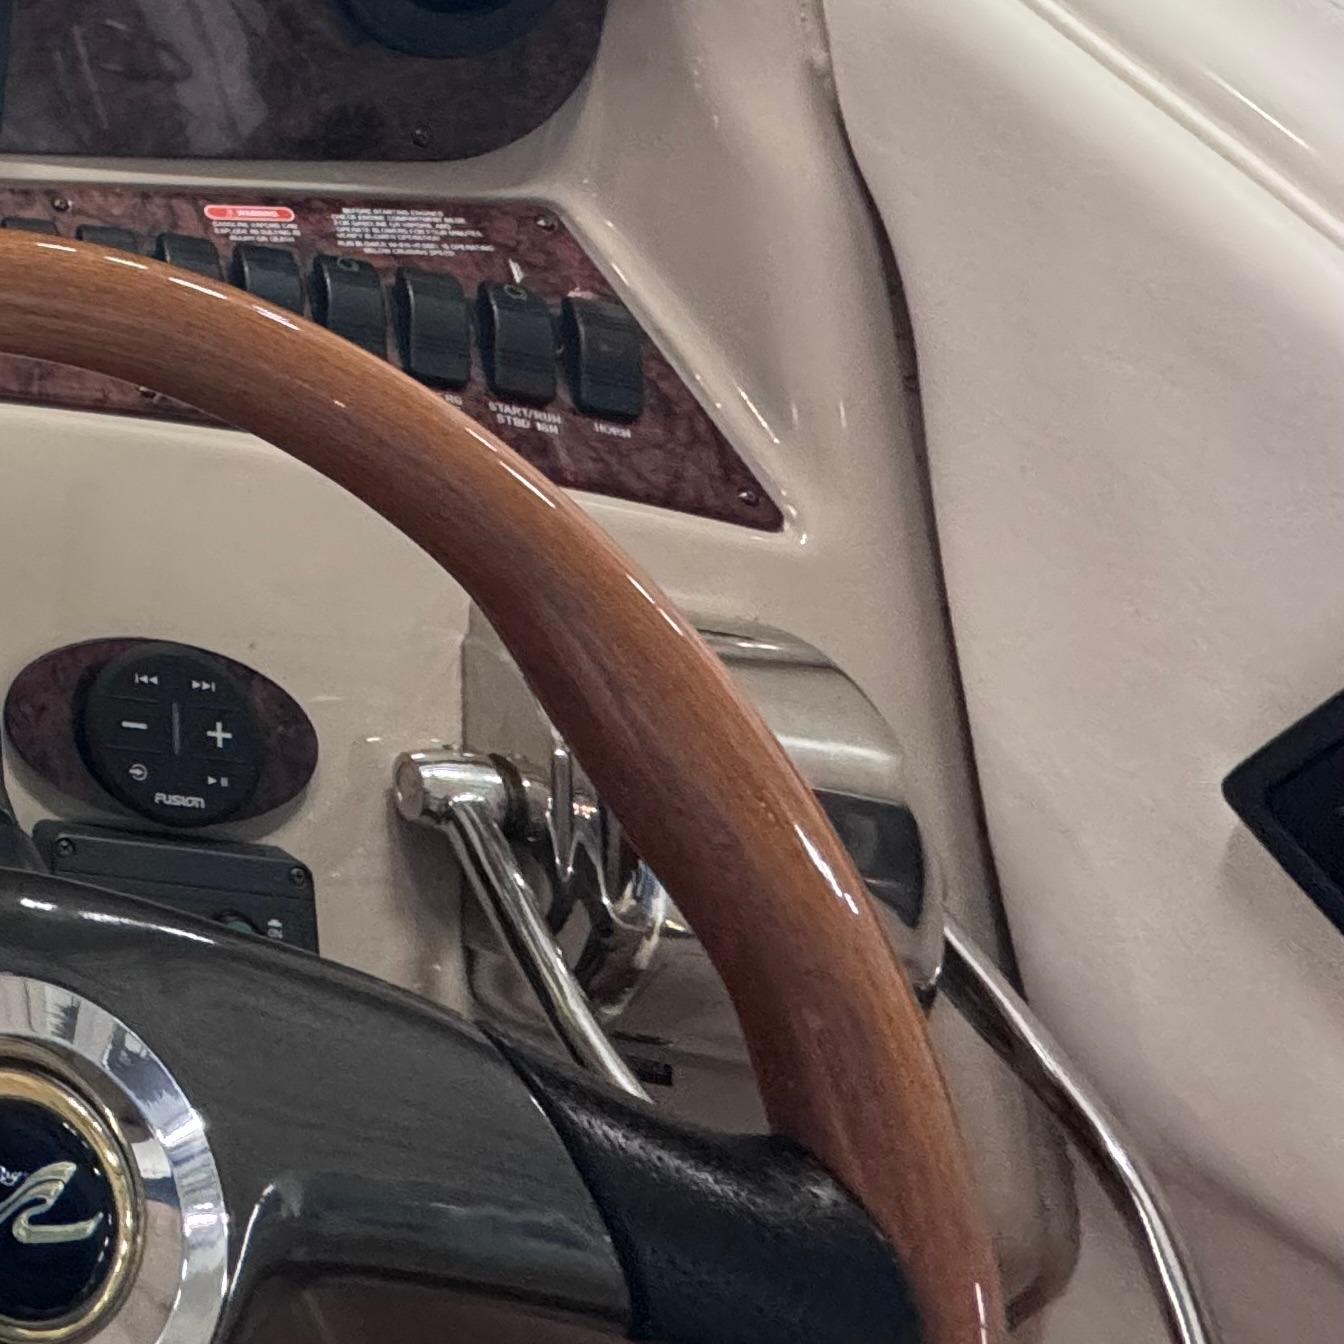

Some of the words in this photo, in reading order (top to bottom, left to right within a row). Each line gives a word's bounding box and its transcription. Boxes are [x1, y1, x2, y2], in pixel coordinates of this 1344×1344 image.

[488, 400, 562, 425] START/RUN
[593, 421, 632, 439] HORN
[153, 792, 206, 810] FUSION
